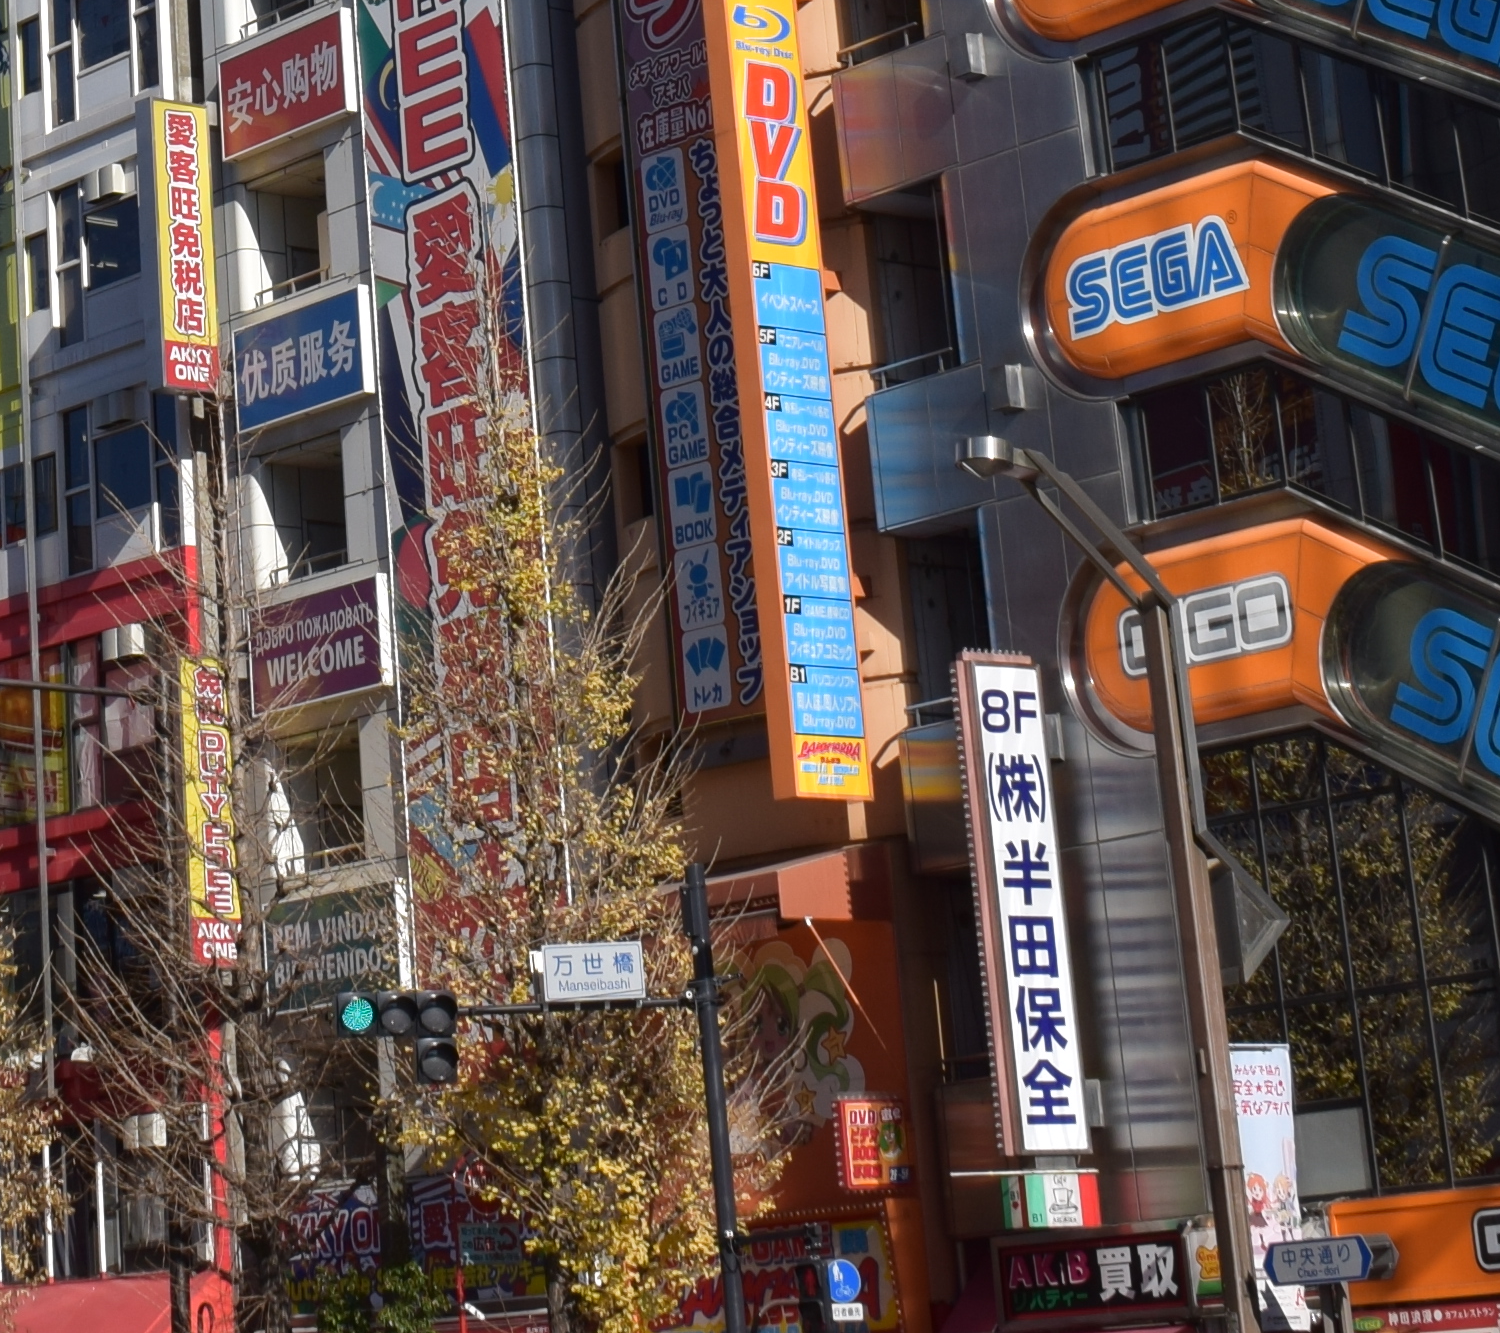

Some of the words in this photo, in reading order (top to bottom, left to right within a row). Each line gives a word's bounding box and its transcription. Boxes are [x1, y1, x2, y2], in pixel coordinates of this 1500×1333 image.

[735, 40, 771, 56] Blu-ray
[226, 41, 339, 135] 安心购物
[652, 73, 690, 108] アキバ
[743, 58, 807, 246] DVD
[649, 188, 680, 214] DVD
[165, 111, 205, 338] 愛客旺免税店
[649, 207, 684, 227] Blu-ray
[752, 261, 771, 279] 6F
[1067, 214, 1251, 343] SEGA
[759, 327, 777, 344] 5F
[174, 363, 209, 385] ONE
[238, 318, 358, 405] 优质服务
[661, 360, 700, 385] GAME
[764, 394, 783, 410] 4F
[667, 421, 690, 445] PC
[668, 440, 709, 466] GAME
[770, 461, 788, 478] 3F
[674, 518, 715, 546] BOOK
[776, 527, 793, 545] 2F
[682, 599, 721, 624] フィギュア
[783, 596, 801, 614] 1F
[255, 620, 295, 655] ДОБРО
[296, 602, 375, 640] ПОЖАЛОВАТЬ
[266, 636, 367, 688] WELCOME
[789, 665, 807, 683] B1
[692, 680, 724, 707] トレカ
[981, 687, 1039, 736] 8F
[198, 729, 228, 820] DUTY
[202, 821, 234, 915] FREE
[986, 749, 1078, 1133] (株)半田保全
[553, 951, 635, 977] 万世橋
[558, 977, 632, 993] Manseibashi
[1234, 1064, 1281, 1077] みんなで協力
[849, 1109, 878, 1125] DVD
[1031, 1213, 1044, 1224] B1
[1280, 1243, 1351, 1269] 中央通り
[1096, 1243, 1179, 1302] 買取
[1297, 1266, 1341, 1279] Chuo-dori
